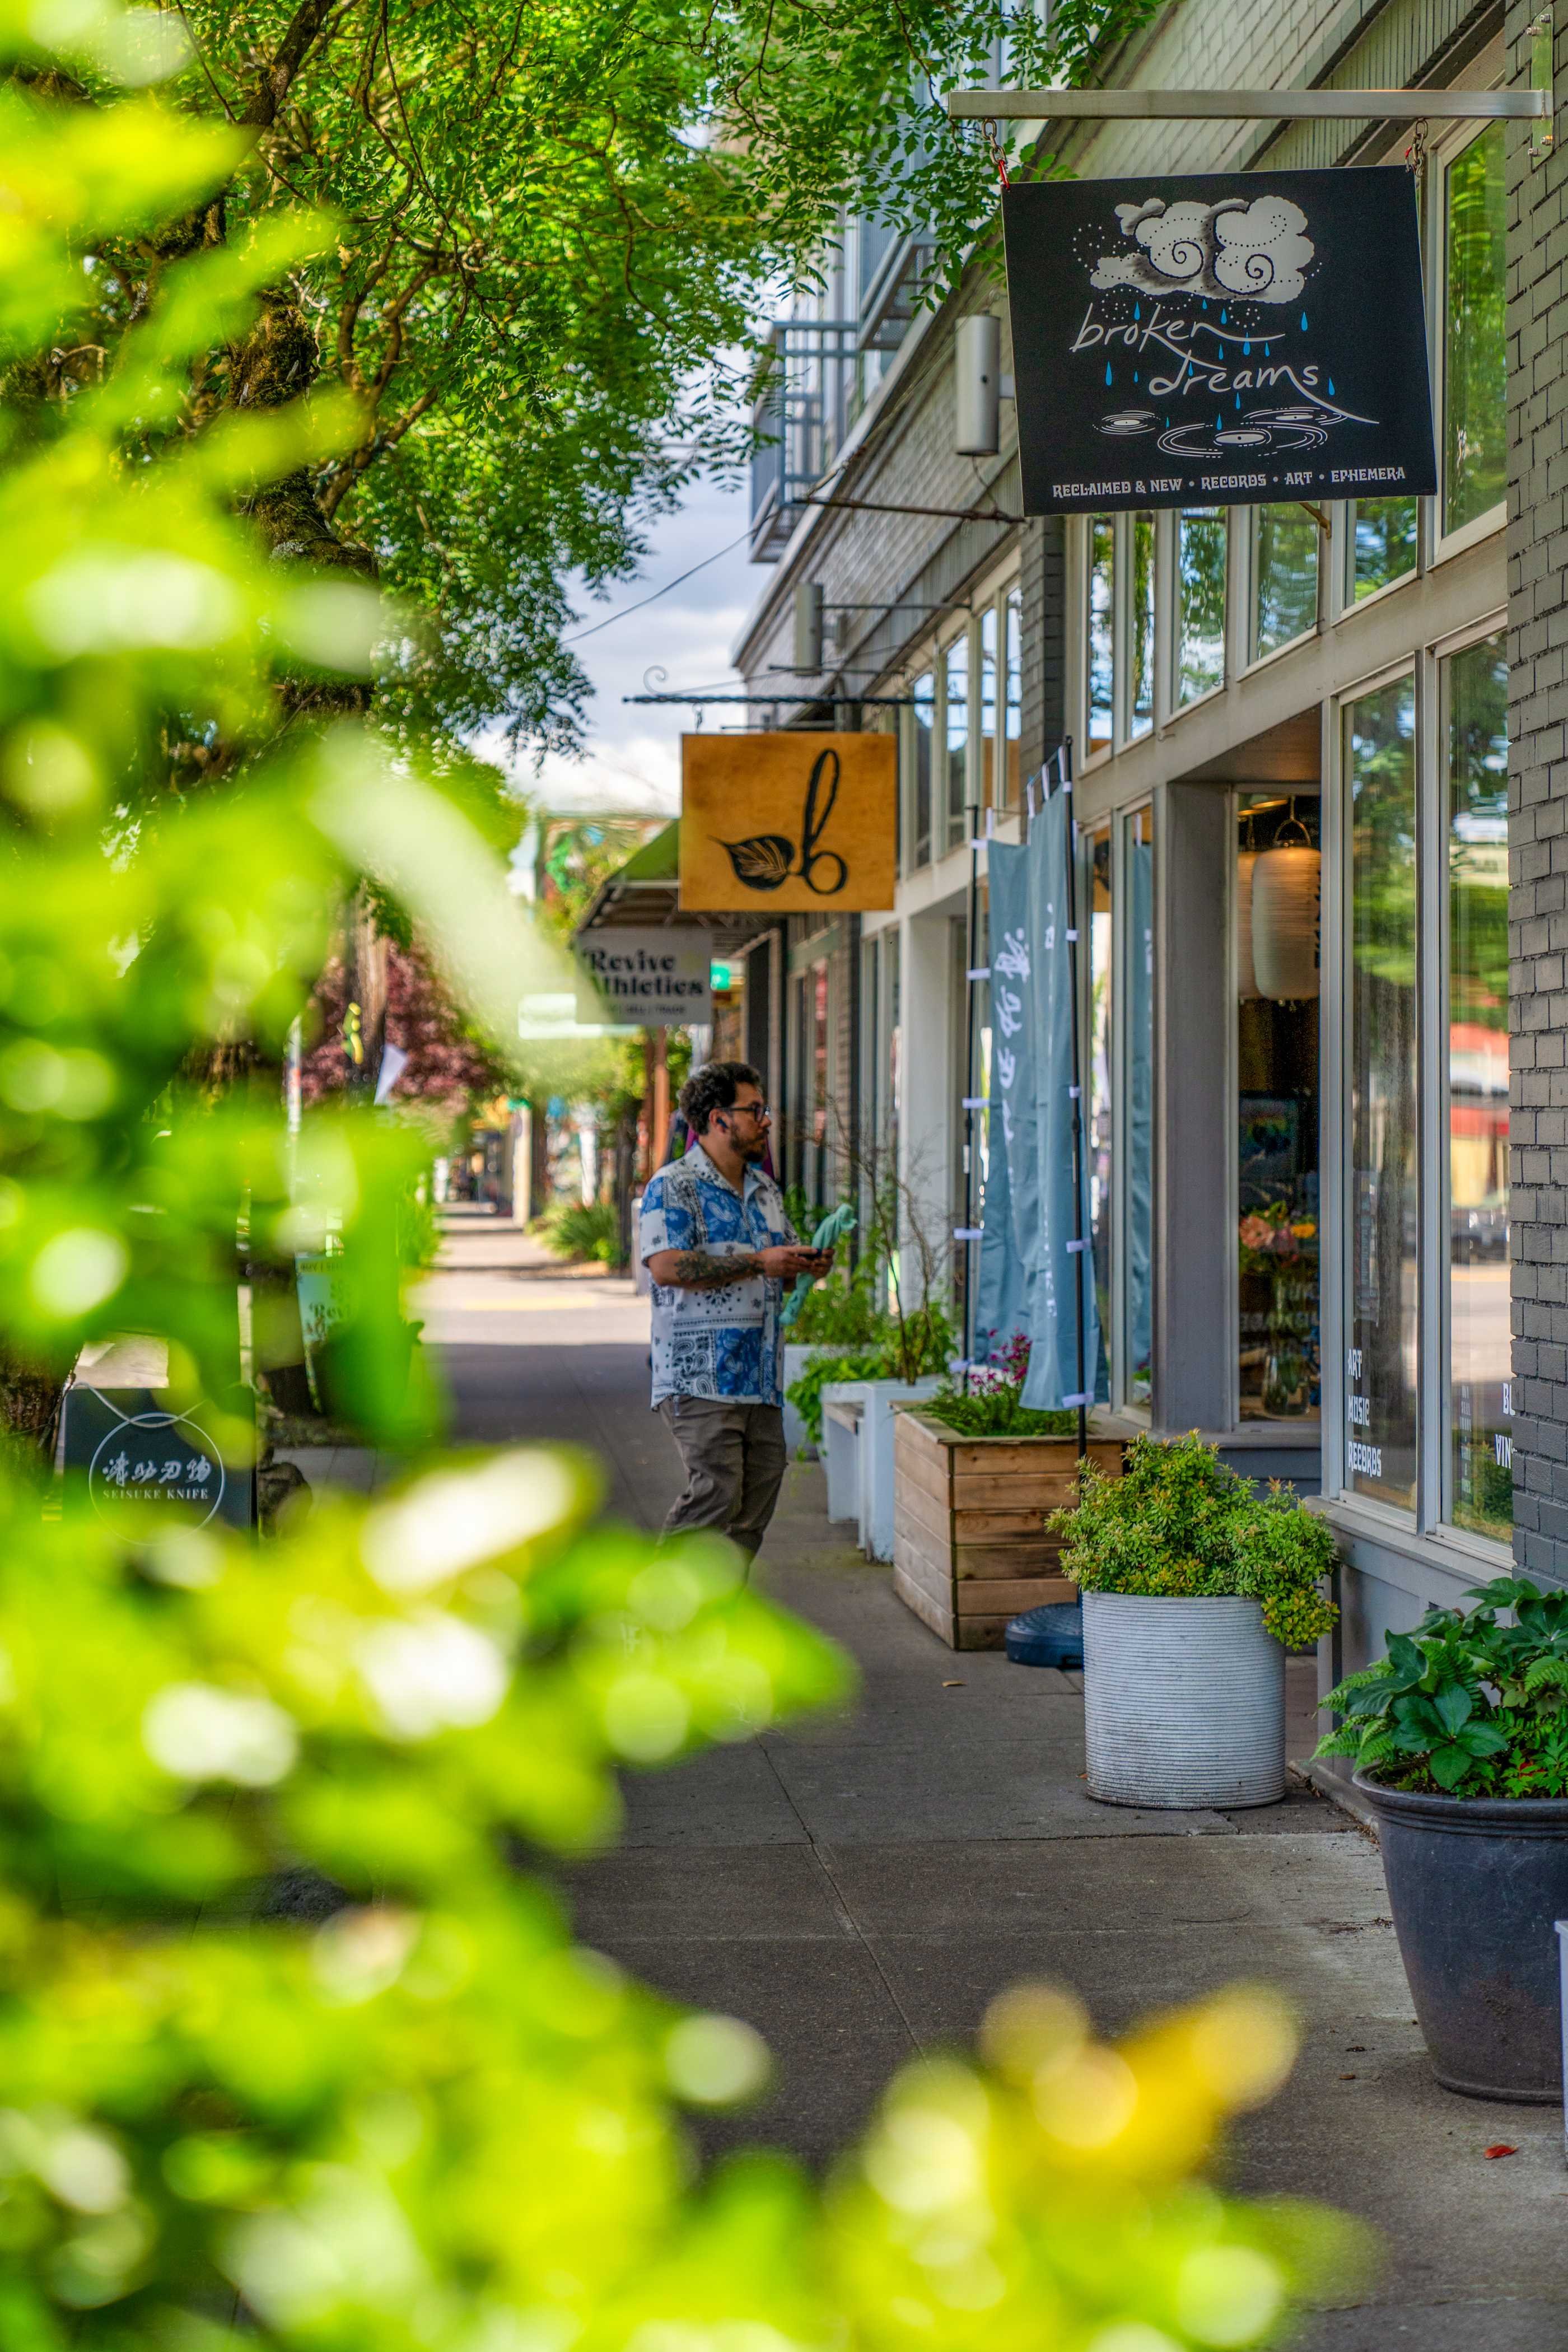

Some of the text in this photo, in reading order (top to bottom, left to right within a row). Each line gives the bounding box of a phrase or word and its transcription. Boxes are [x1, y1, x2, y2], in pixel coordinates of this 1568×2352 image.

[1069, 303, 1286, 370] broken
[1149, 351, 1380, 424] dreams
[1053, 468, 1405, 498] RECLAIMED & NEW RECORDS ART EPHEMERA
[1348, 1348, 1362, 1379] ART
[1348, 1395, 1370, 1426] MUSIC
[1348, 1441, 1382, 1477] RECORDS
[103, 1488, 209, 1500] SEISUKE KNIFE
